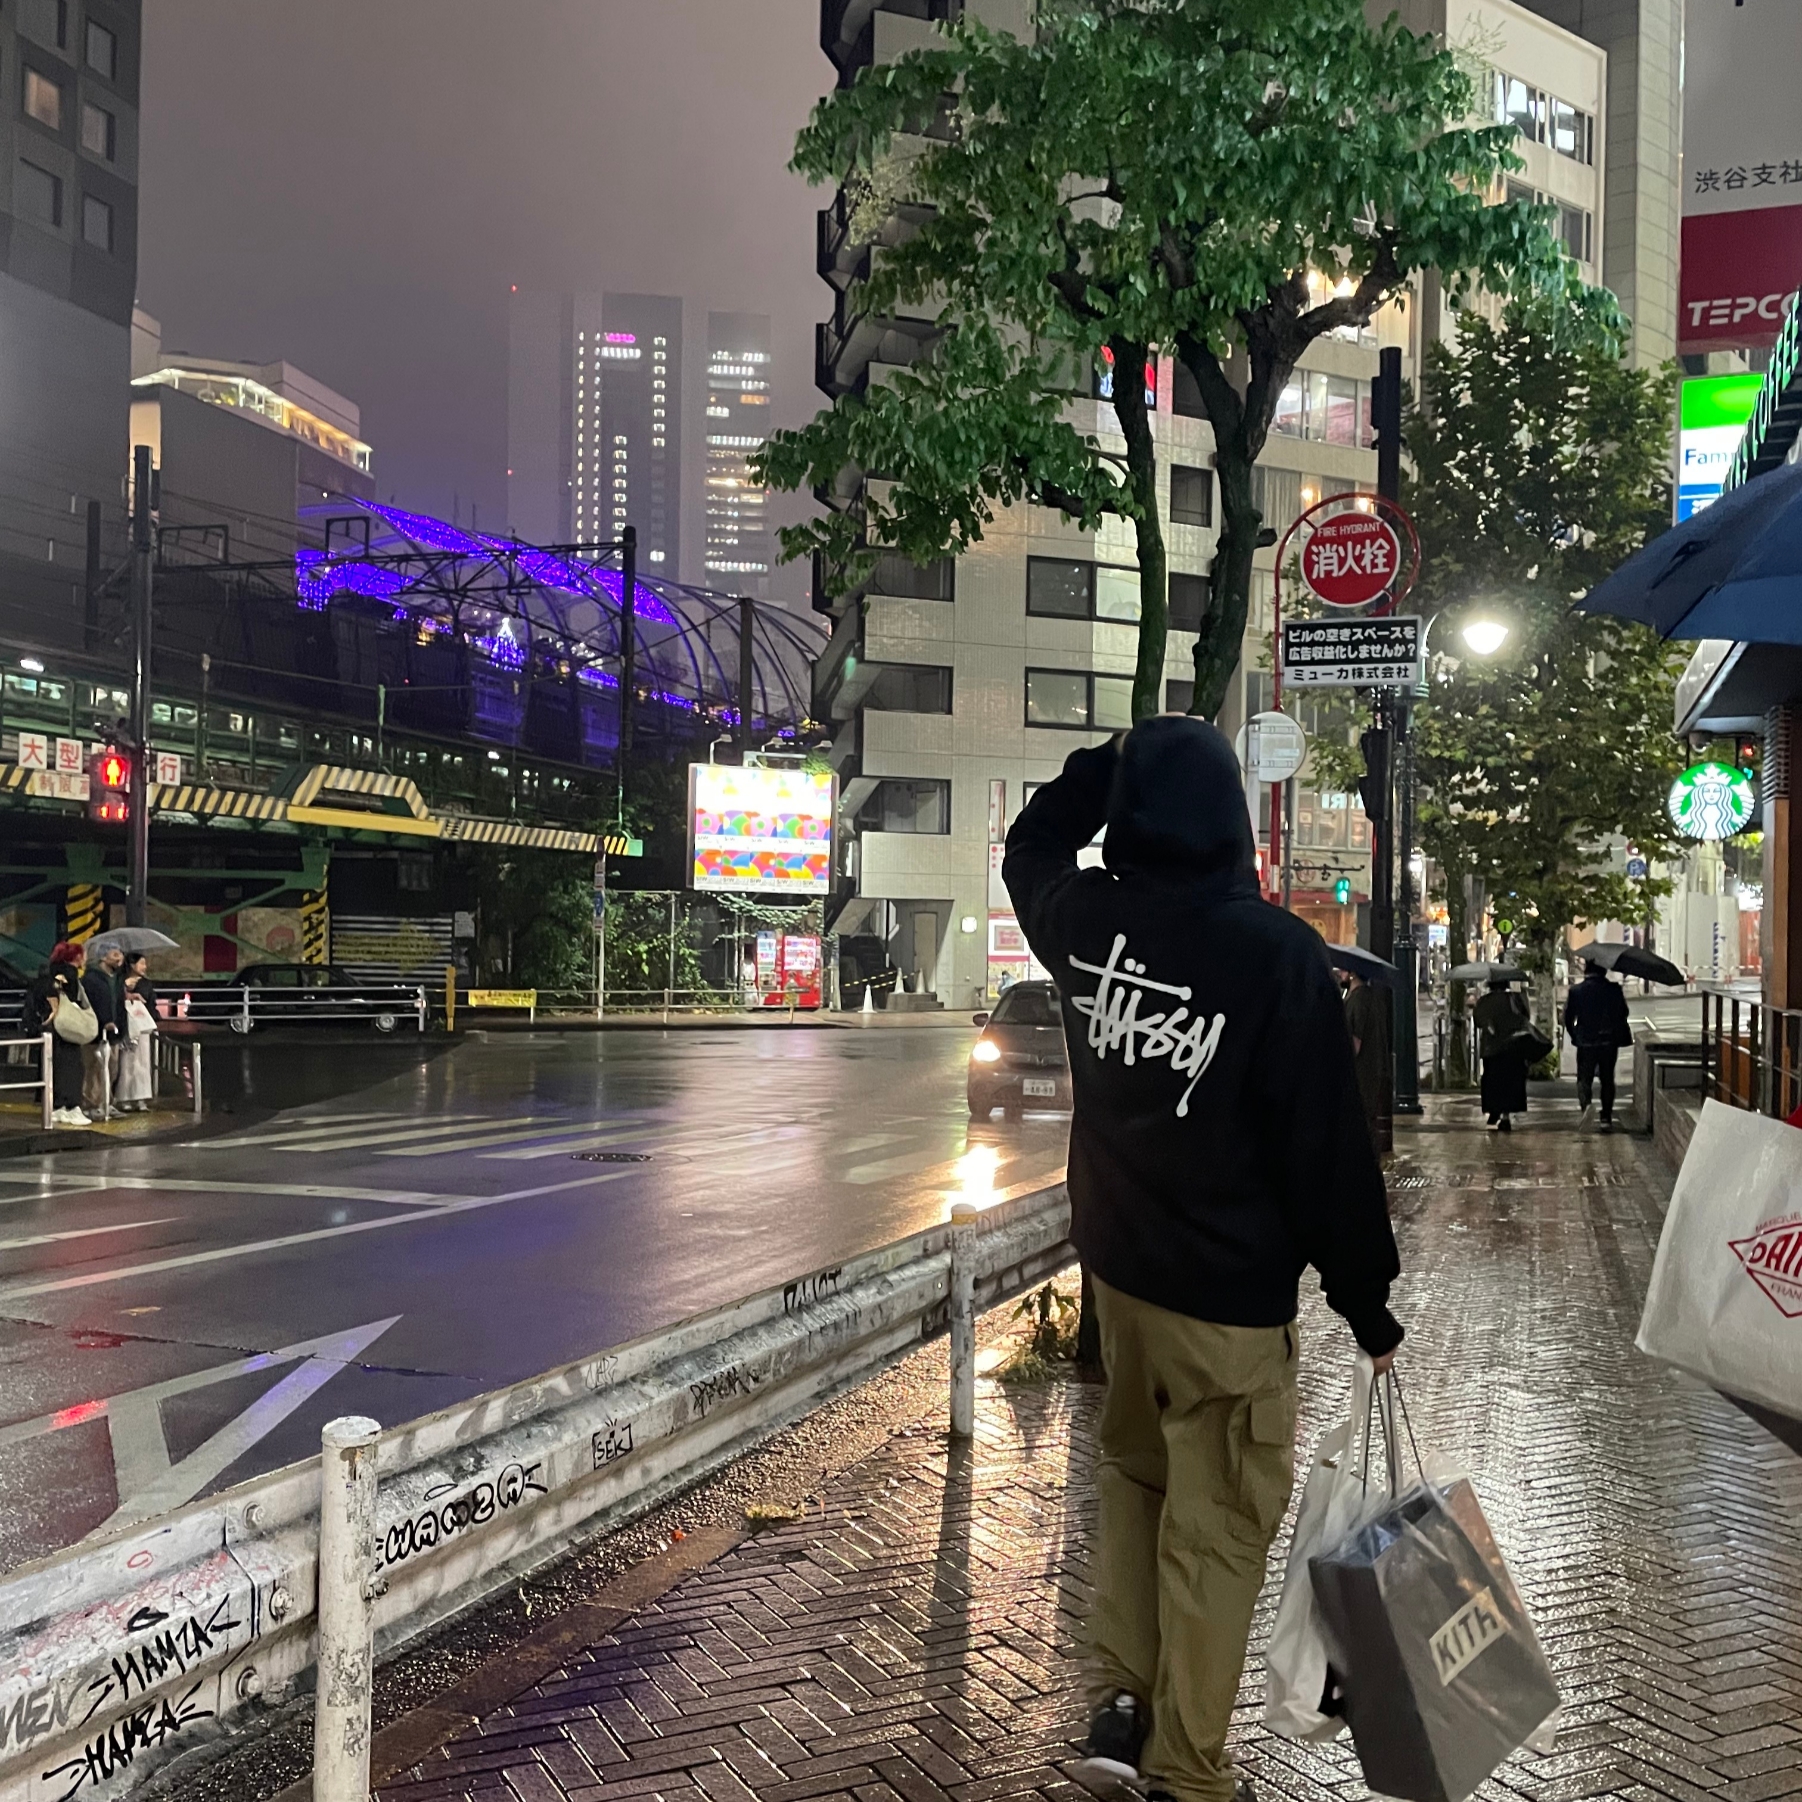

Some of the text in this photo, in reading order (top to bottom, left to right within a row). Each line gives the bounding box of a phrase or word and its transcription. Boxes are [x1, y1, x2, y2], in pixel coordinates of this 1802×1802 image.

[1694, 160, 1802, 194] 渋谷支社
[1317, 521, 1381, 538] FIRE HYDRANT
[1310, 538, 1390, 579] 消火栓
[1288, 626, 1416, 642] ビルの空きスペースを
[1288, 643, 1416, 661] 広告収益化しませんか?
[1293, 666, 1410, 681] ミューカ株式会社
